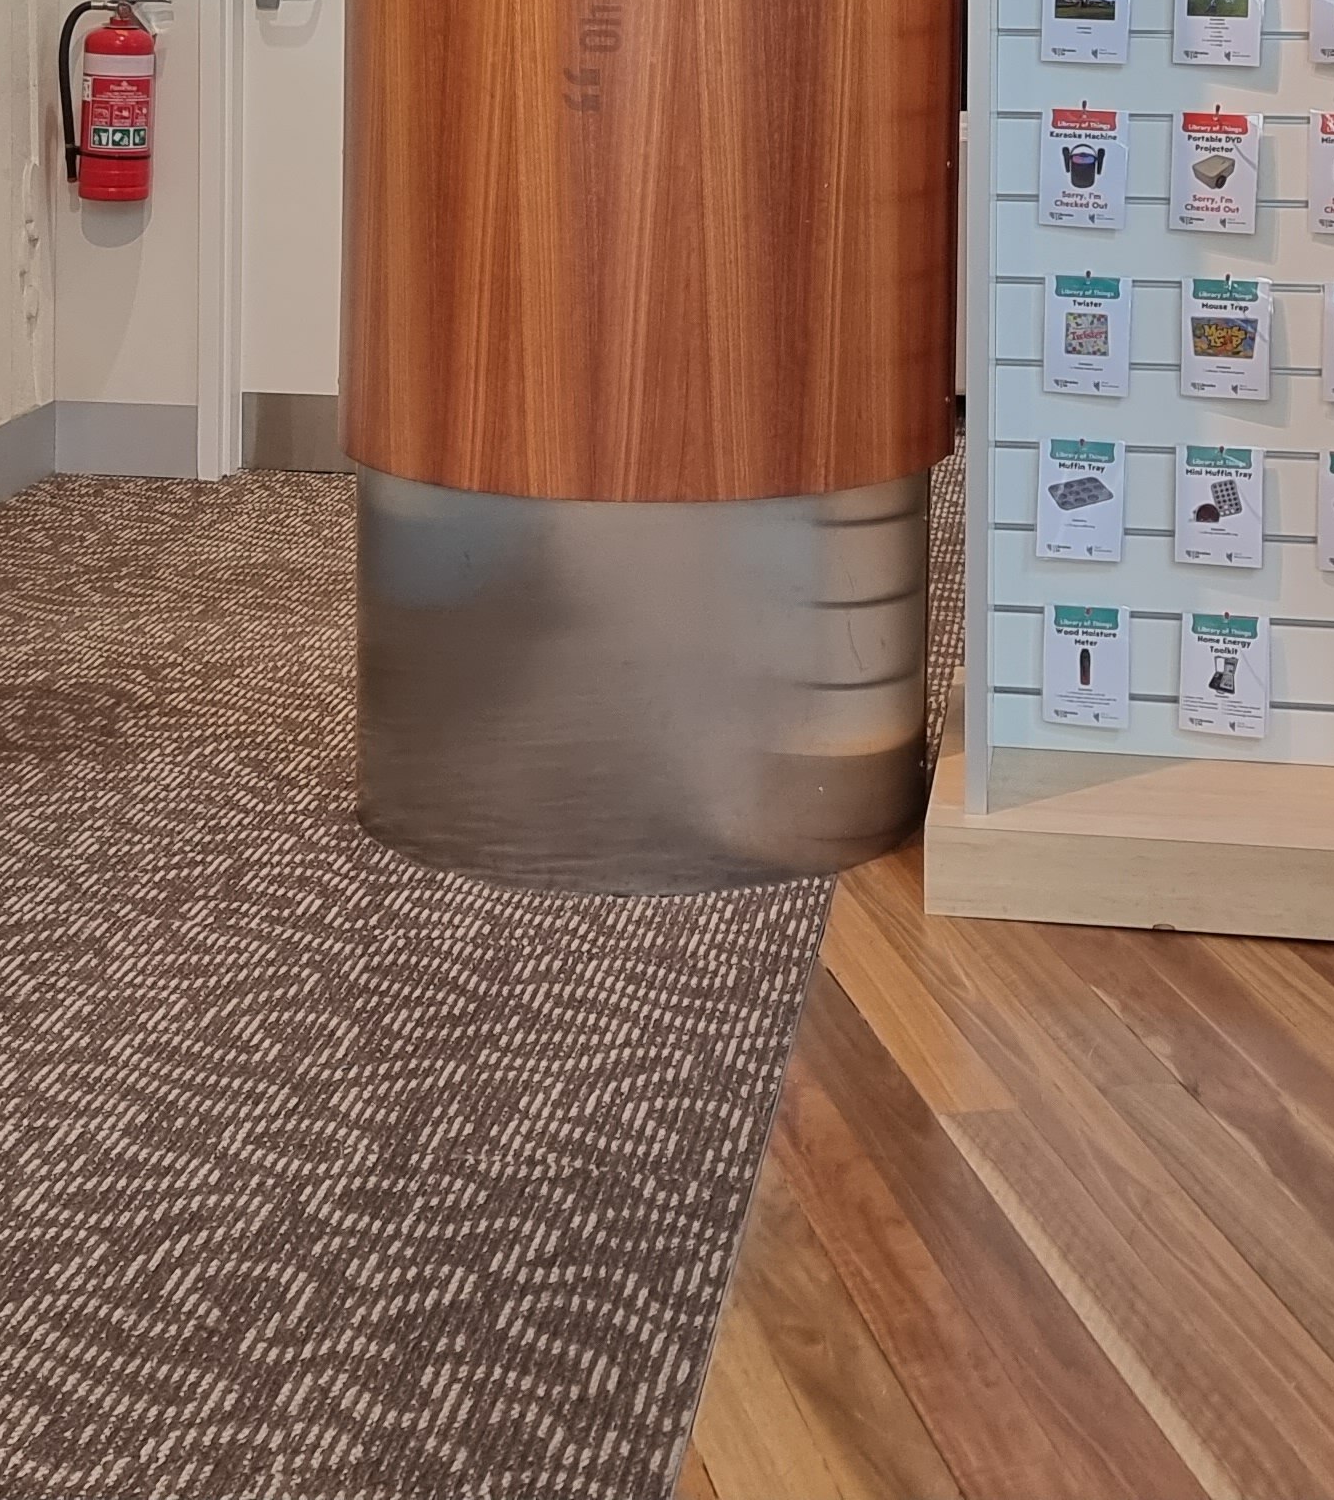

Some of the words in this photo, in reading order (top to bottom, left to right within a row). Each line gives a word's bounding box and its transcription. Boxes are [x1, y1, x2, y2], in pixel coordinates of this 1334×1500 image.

[1050, 131, 1083, 140] Karaoke
[1084, 132, 1118, 141] Machine
[1187, 135, 1223, 143] Portable
[1225, 136, 1242, 144] DVD
[1195, 145, 1234, 154] Projector
[1073, 300, 1102, 308] Twister
[1202, 303, 1227, 311] Mouse
[1230, 304, 1249, 313] Trap
[1070, 330, 1106, 342] Twister
[1059, 463, 1085, 471] Muffin
[1087, 464, 1106, 474] Tray
[1186, 469, 1203, 477] Mini
[1205, 469, 1232, 478] Muffin
[1234, 471, 1253, 480] Tray
[1056, 628, 1078, 637] Wood
[1081, 630, 1117, 638] Moisture
[1075, 638, 1098, 647] Meter
[1197, 635, 1221, 645] Home
[1222, 637, 1251, 649] Energy
[1210, 646, 1238, 656] Toolkit
